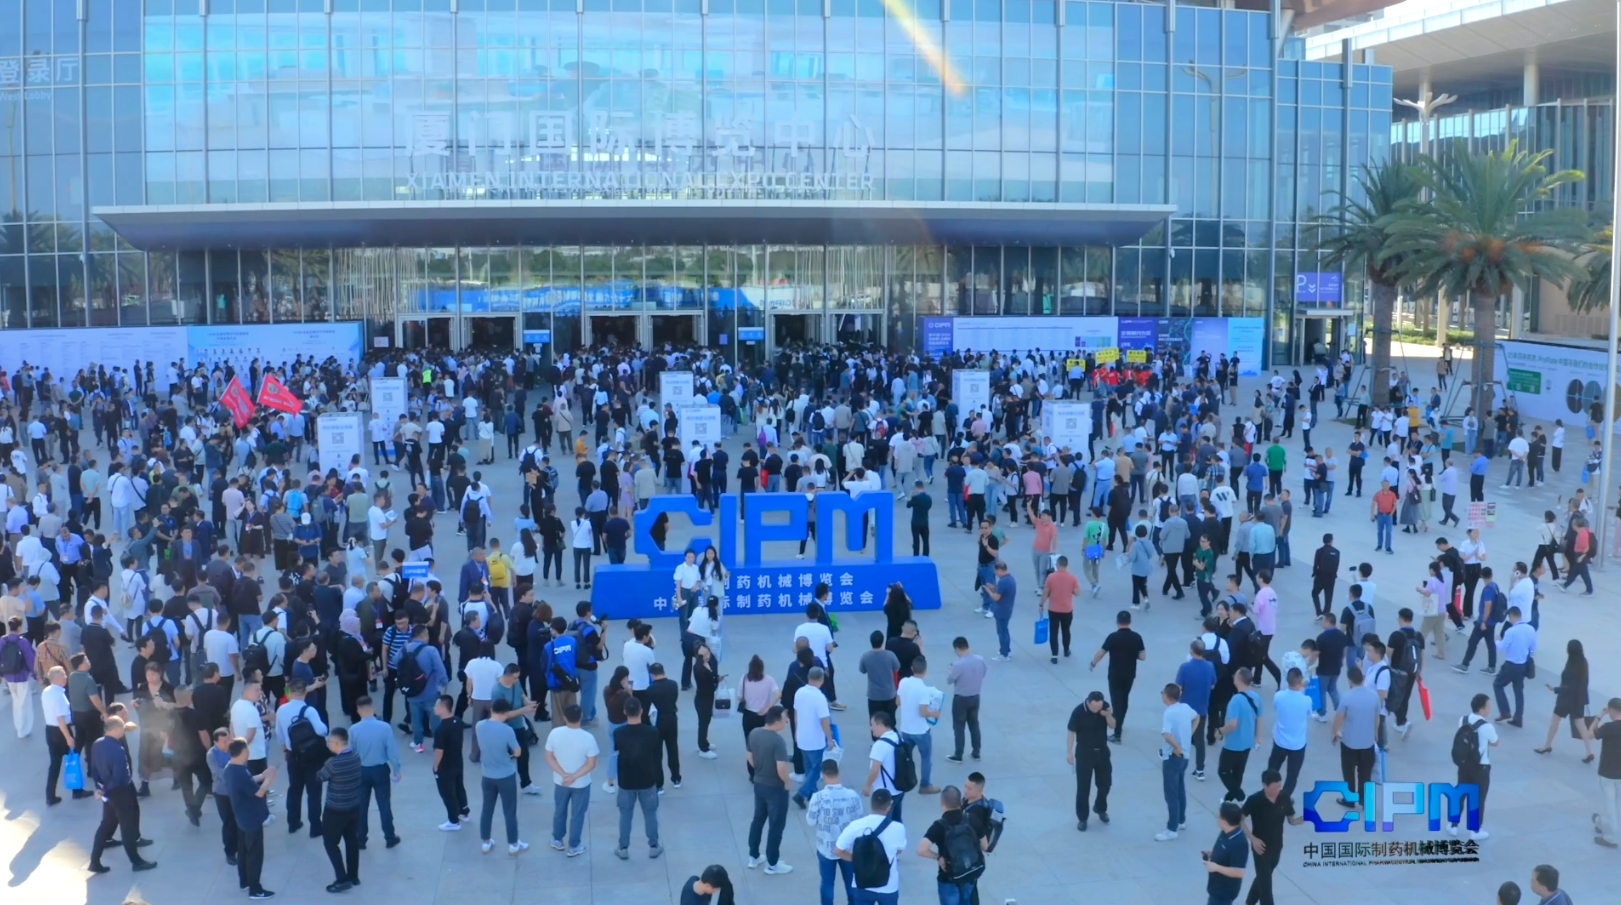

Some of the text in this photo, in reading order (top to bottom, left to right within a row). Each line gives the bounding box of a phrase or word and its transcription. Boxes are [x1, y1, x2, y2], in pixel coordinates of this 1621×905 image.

[0, 58, 79, 83] 登录厅
[24, 91, 52, 101] Lobby
[404, 110, 876, 158] 厦门国际博览中心
[406, 171, 875, 191] XIAMEN INTERNATIONAL EXPO CENTER
[1296, 274, 1307, 293] P
[633, 490, 894, 571] CIPM
[674, 572, 854, 592] 药机械博览会
[653, 590, 875, 612] 中际制药机械博览会
